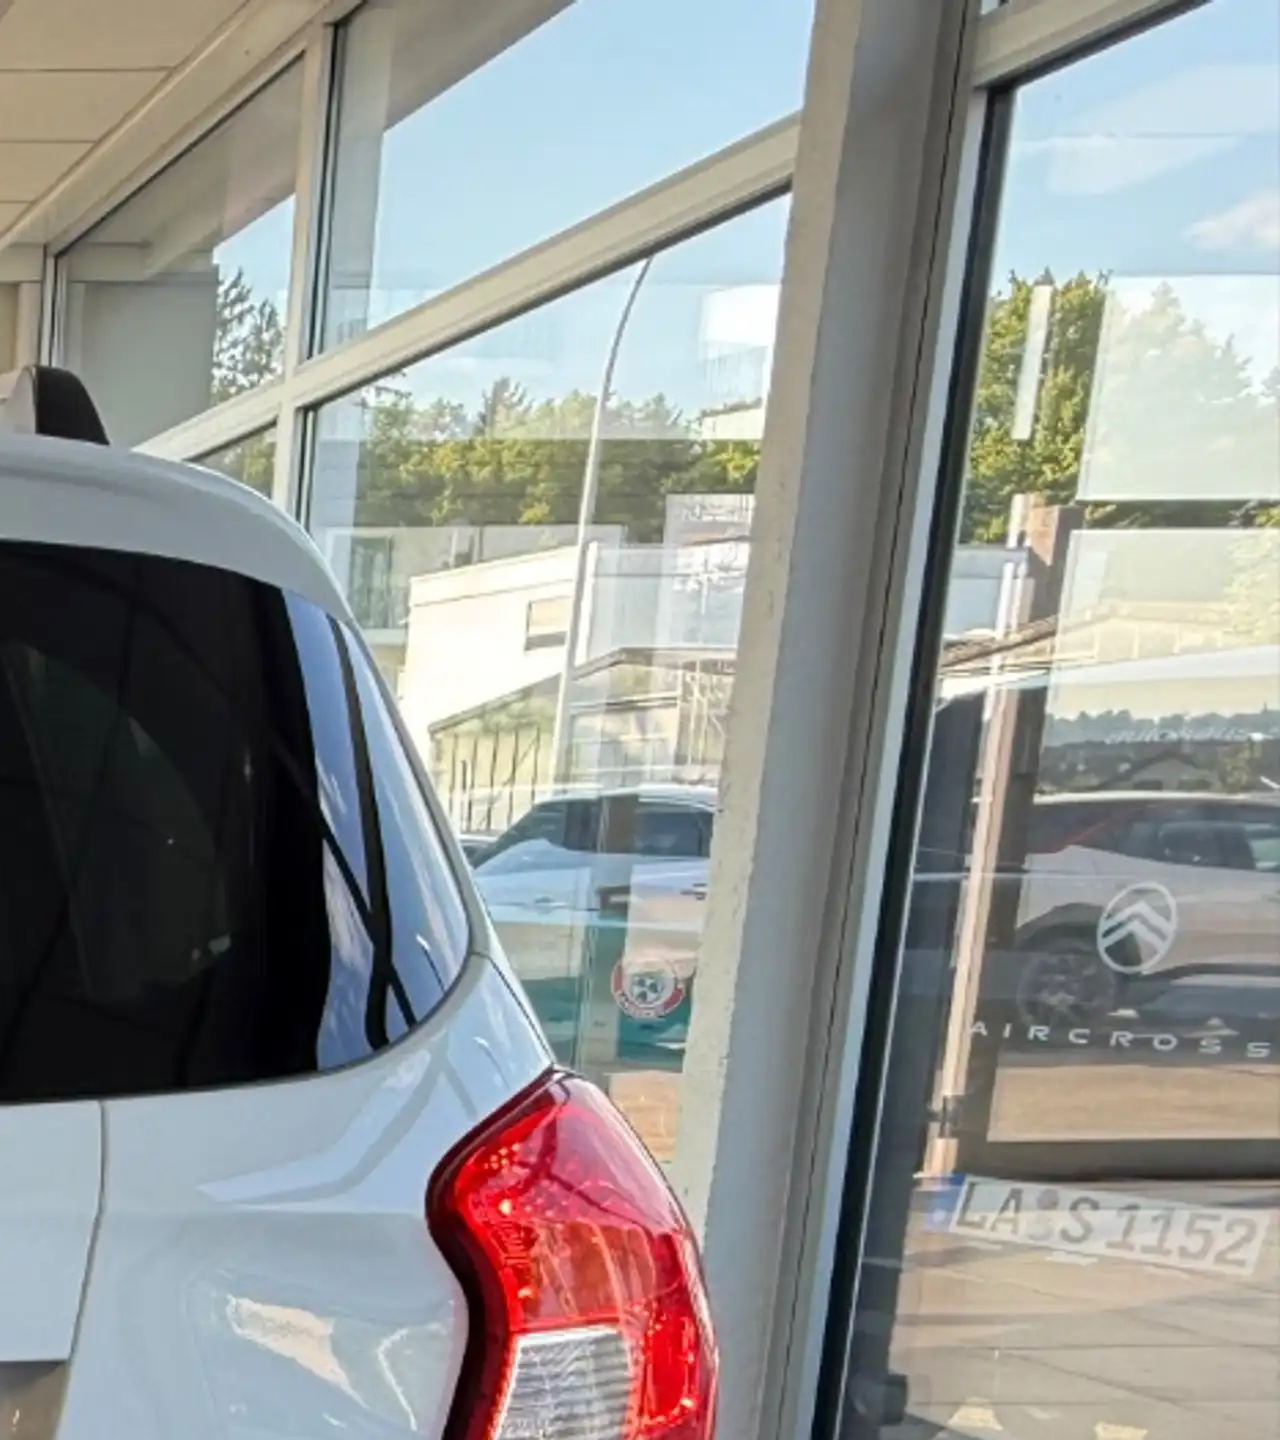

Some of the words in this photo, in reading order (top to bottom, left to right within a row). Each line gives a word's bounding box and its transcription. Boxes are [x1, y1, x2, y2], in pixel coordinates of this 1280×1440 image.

[967, 1020, 1273, 1059] AIRCROSS
[955, 1181, 1024, 1236] LA
[1058, 1196, 1101, 1245] S
[1104, 1203, 1259, 1270] 1152
